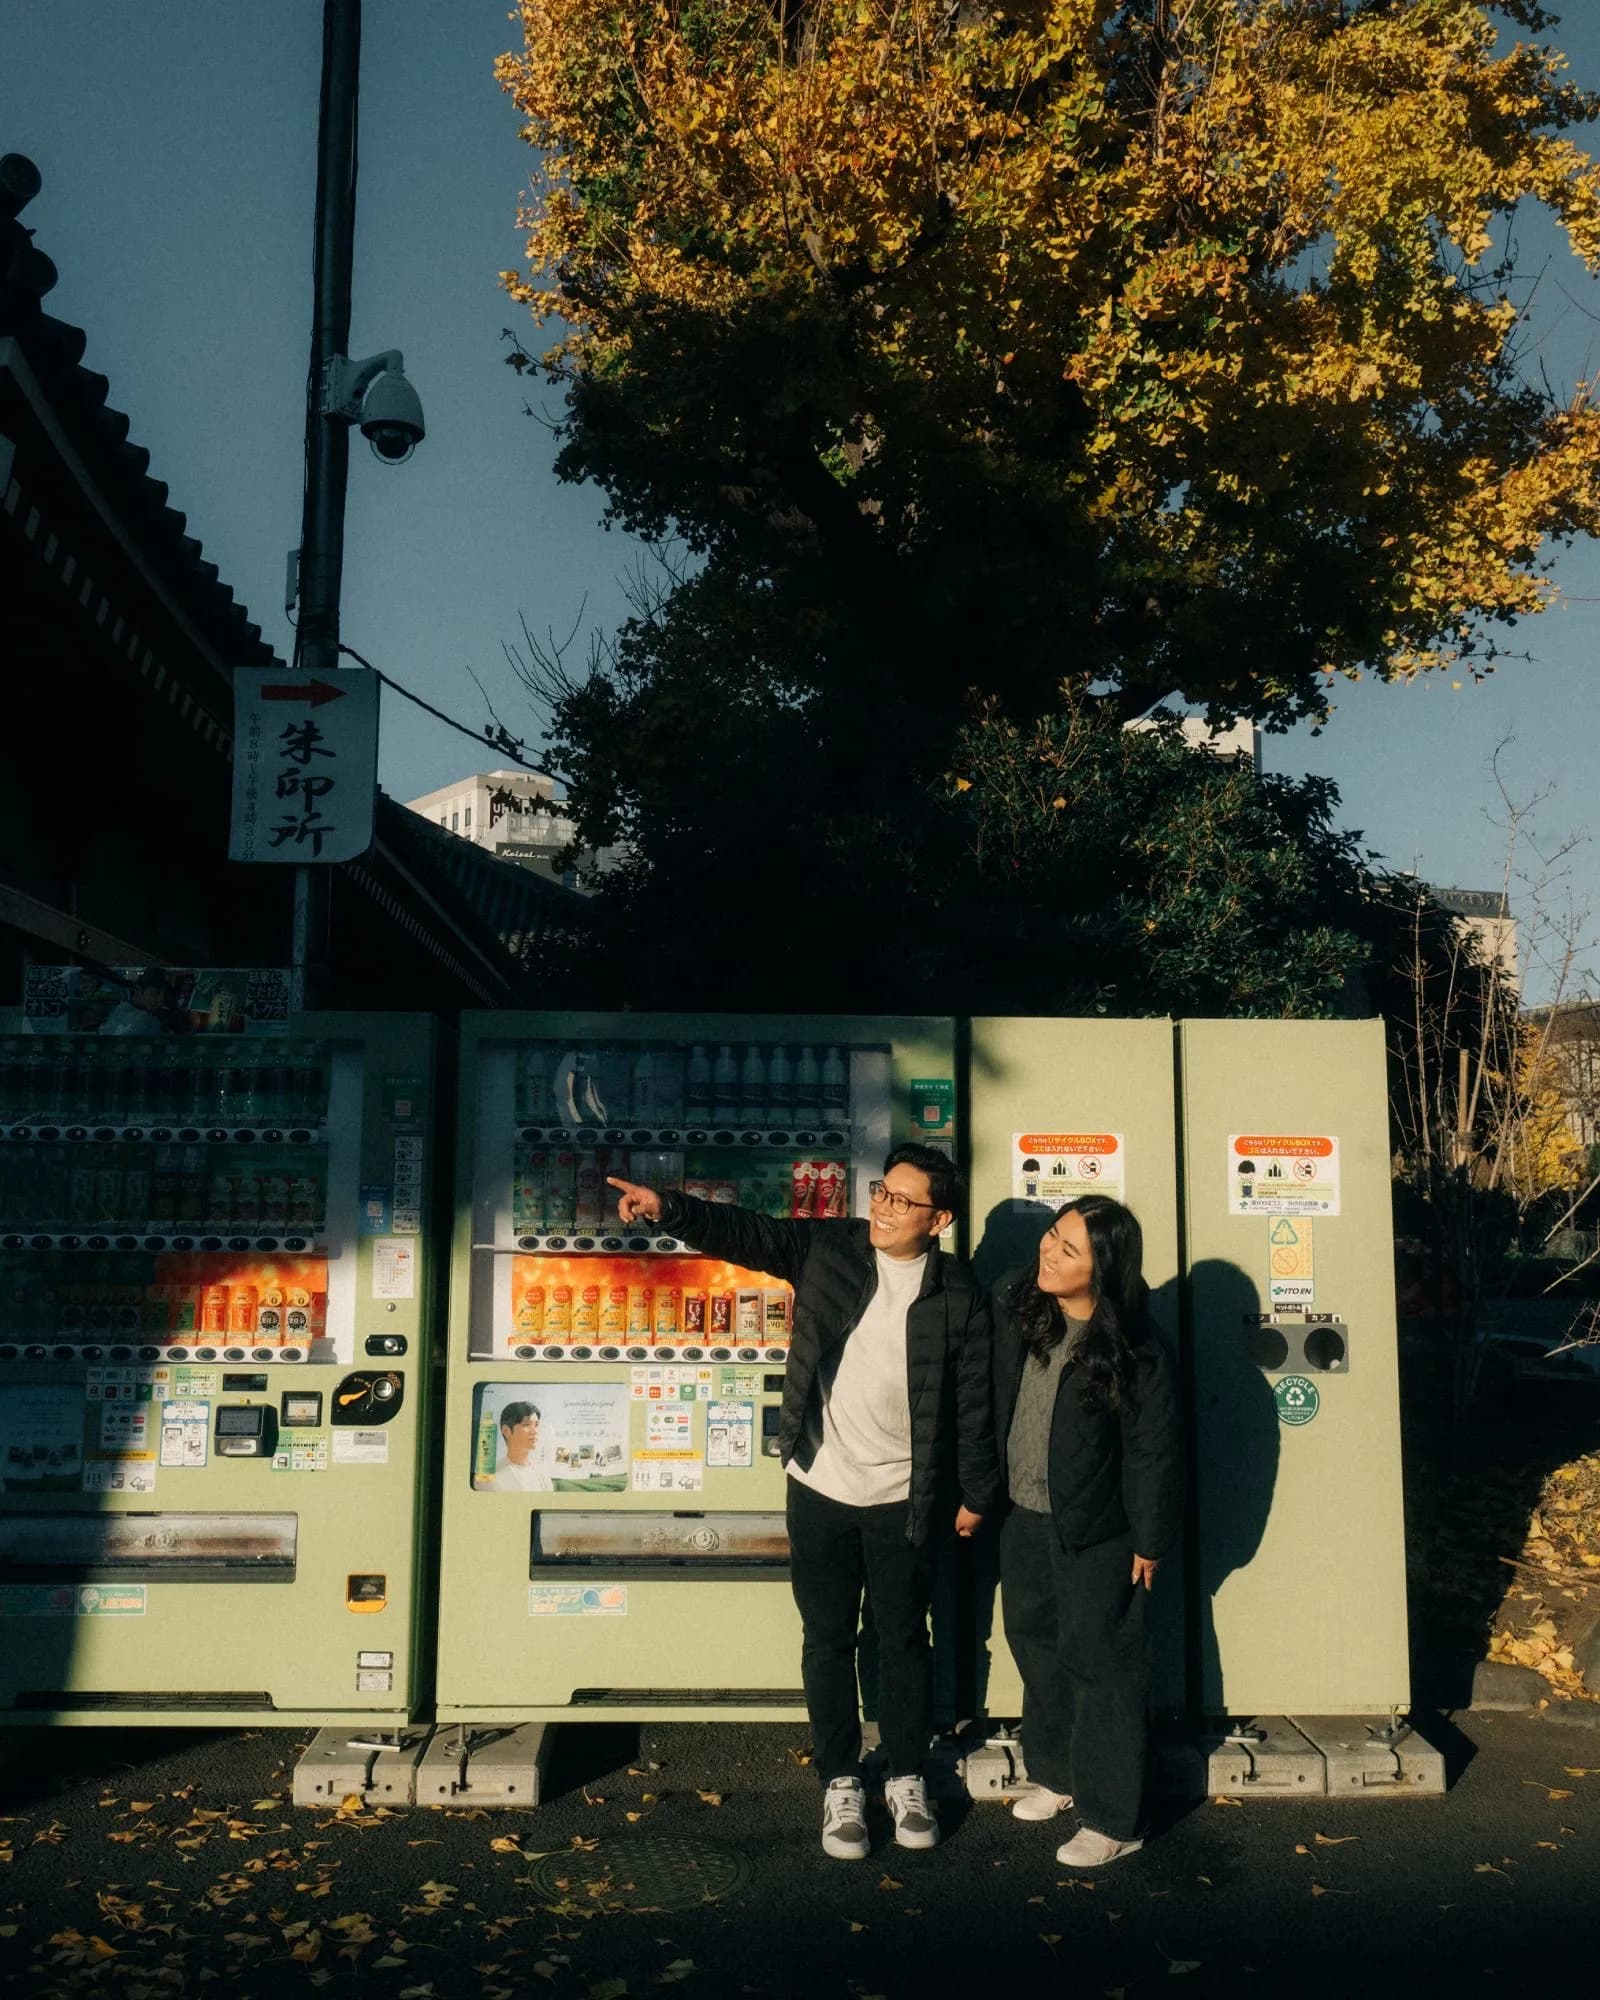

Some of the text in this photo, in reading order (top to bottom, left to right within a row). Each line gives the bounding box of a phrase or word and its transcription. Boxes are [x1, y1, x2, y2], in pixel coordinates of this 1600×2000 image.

[267, 719, 337, 857] 朱印所
[744, 1320, 754, 1328] 20
[1275, 1377, 1316, 1395] RECYCLE
